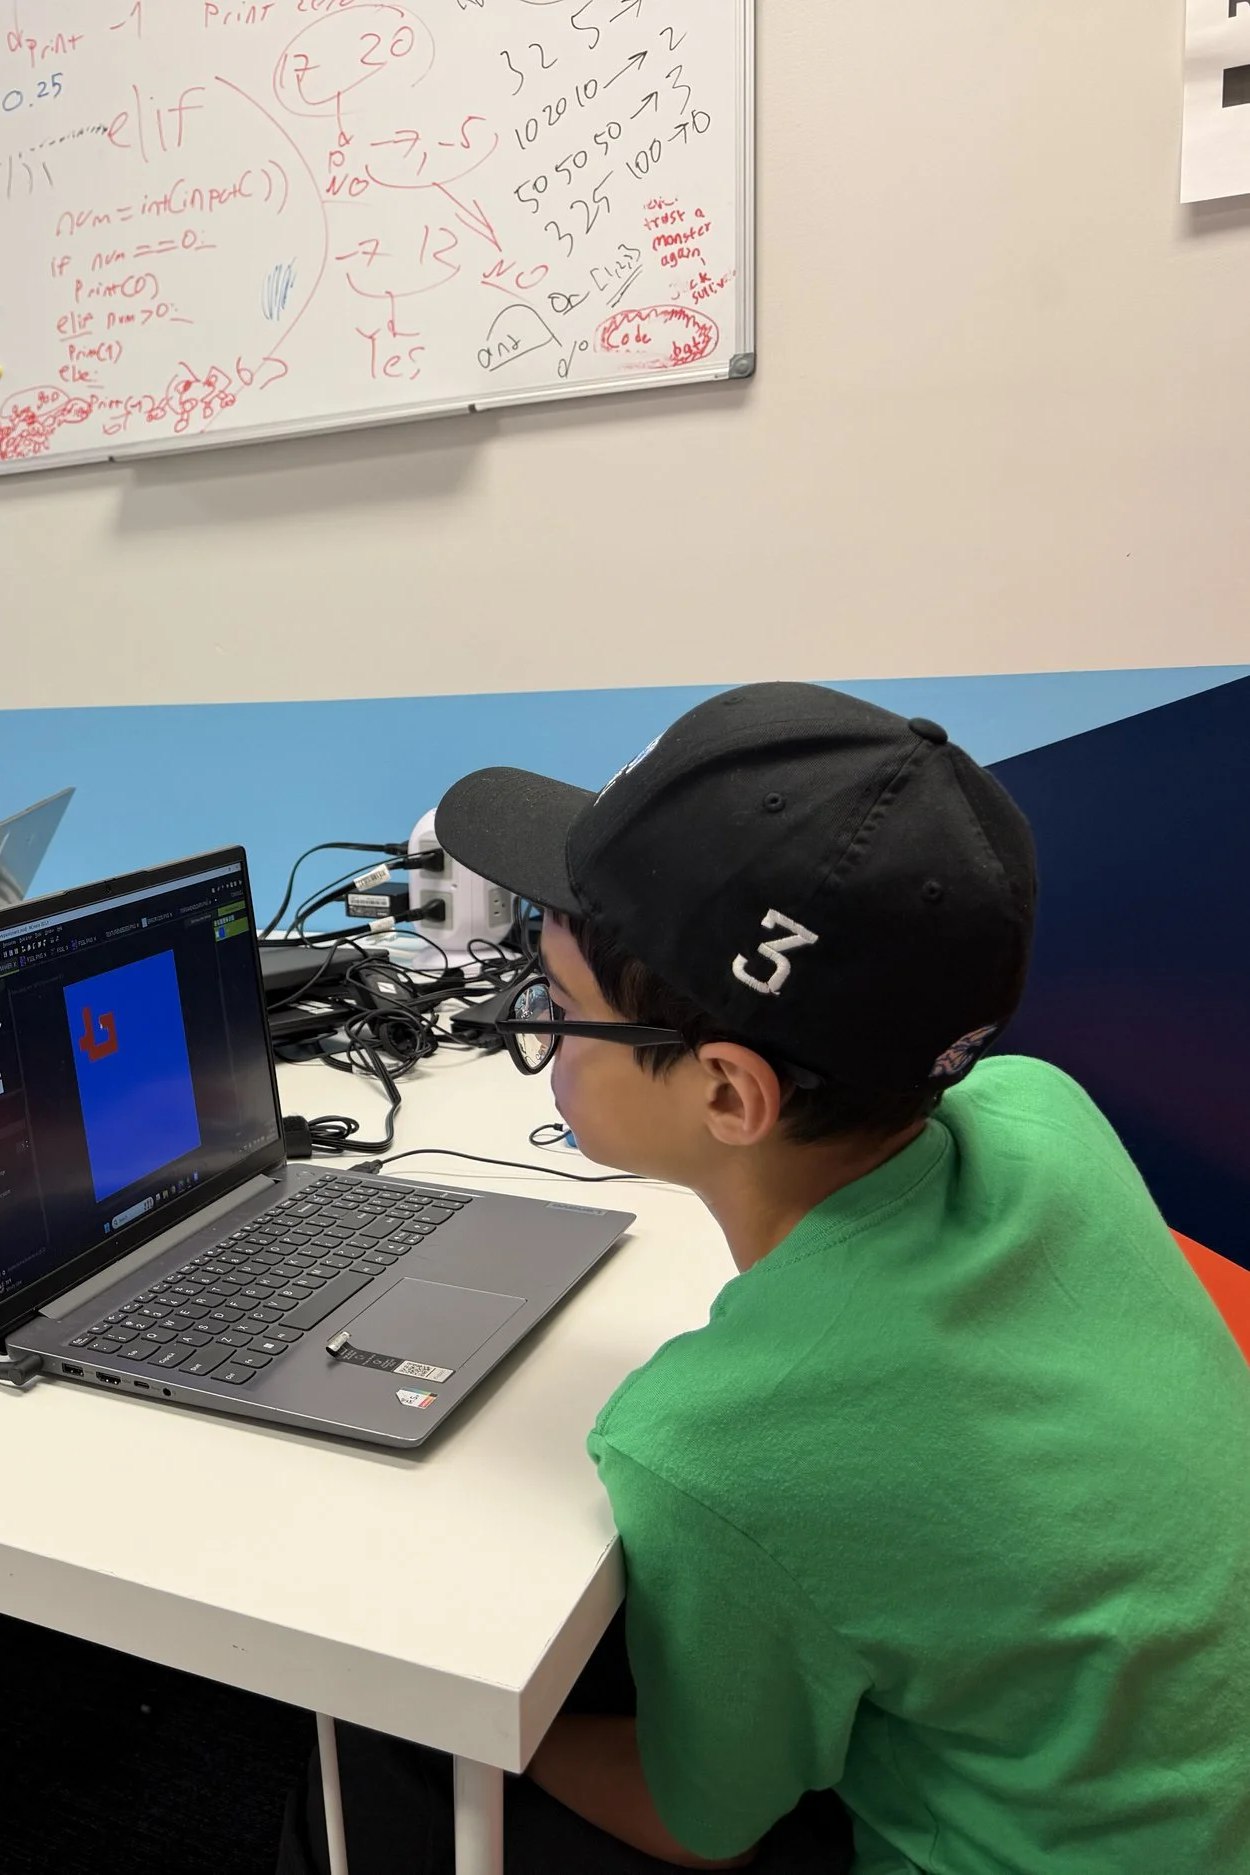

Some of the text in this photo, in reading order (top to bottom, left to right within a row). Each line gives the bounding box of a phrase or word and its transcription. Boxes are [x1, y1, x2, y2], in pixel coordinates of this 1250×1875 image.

[359, 25, 415, 66] 20
[1, 72, 64, 112] 0.25
[731, 907, 820, 996] 3
